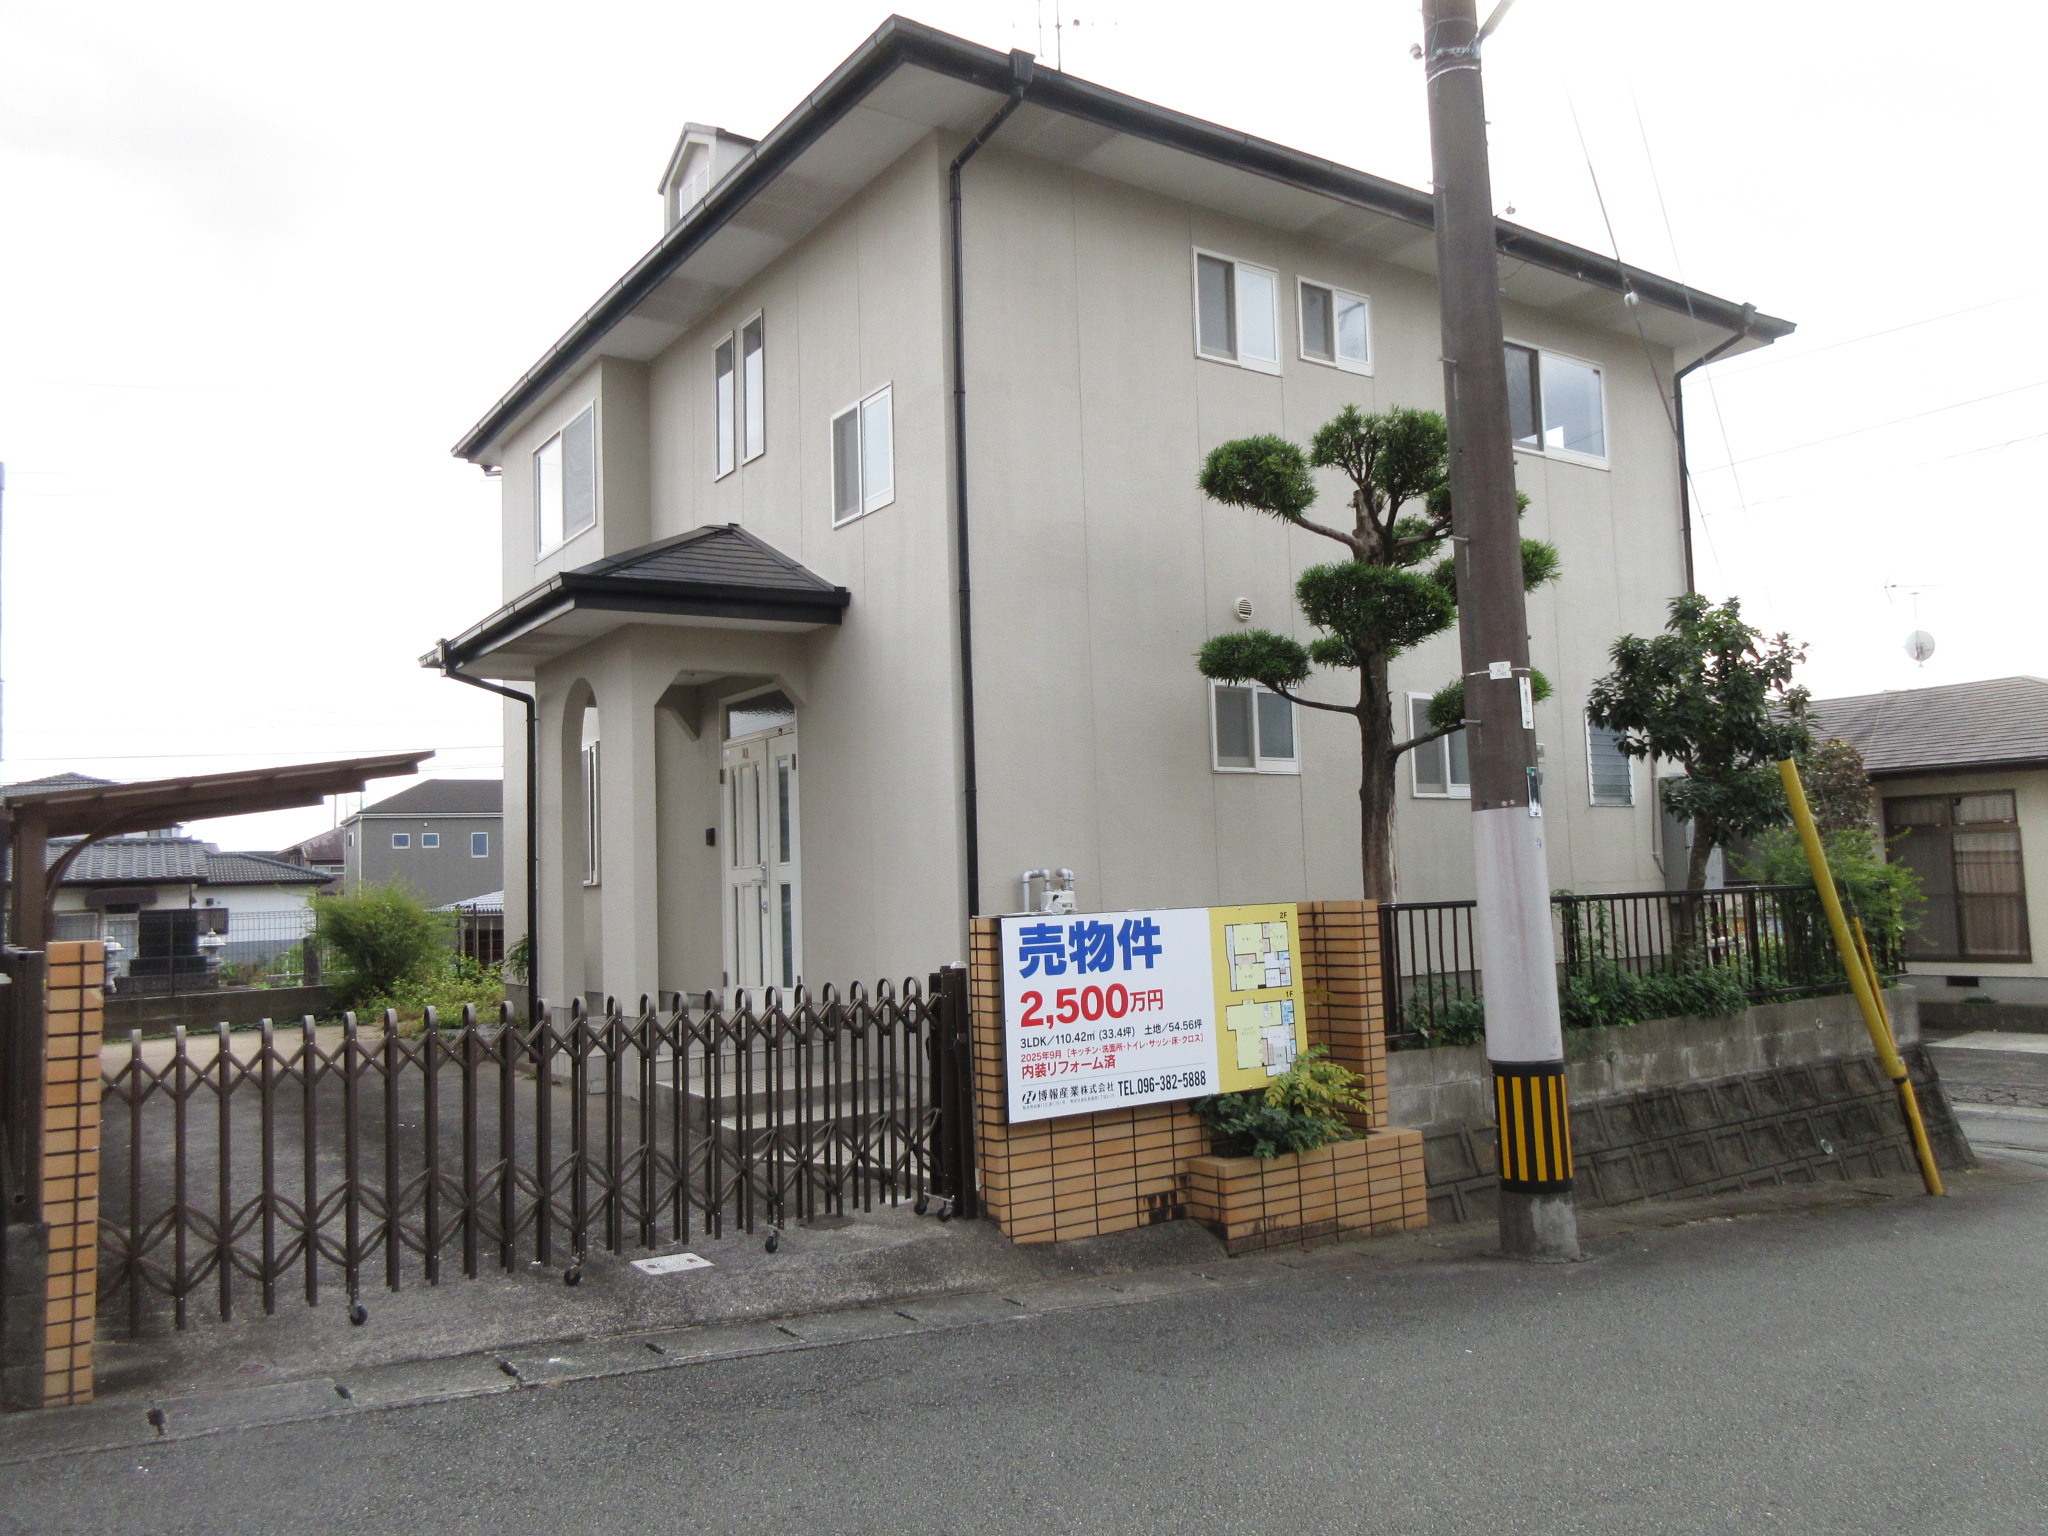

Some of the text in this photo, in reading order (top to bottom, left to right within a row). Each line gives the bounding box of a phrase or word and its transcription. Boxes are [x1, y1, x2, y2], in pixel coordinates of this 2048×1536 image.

[1279, 911, 1288, 919] 2F
[1018, 916, 1163, 979] 売物件
[1020, 983, 1164, 1030] 2,500万円
[1286, 990, 1294, 998] 1F
[1020, 1050, 1062, 1063] 2025年9月
[1021, 1054, 1116, 1080] 内装リフォーム済
[1037, 1081, 1115, 1102] 博報産業株式会社
[1117, 1070, 1207, 1097] TEL.096-382-5888
